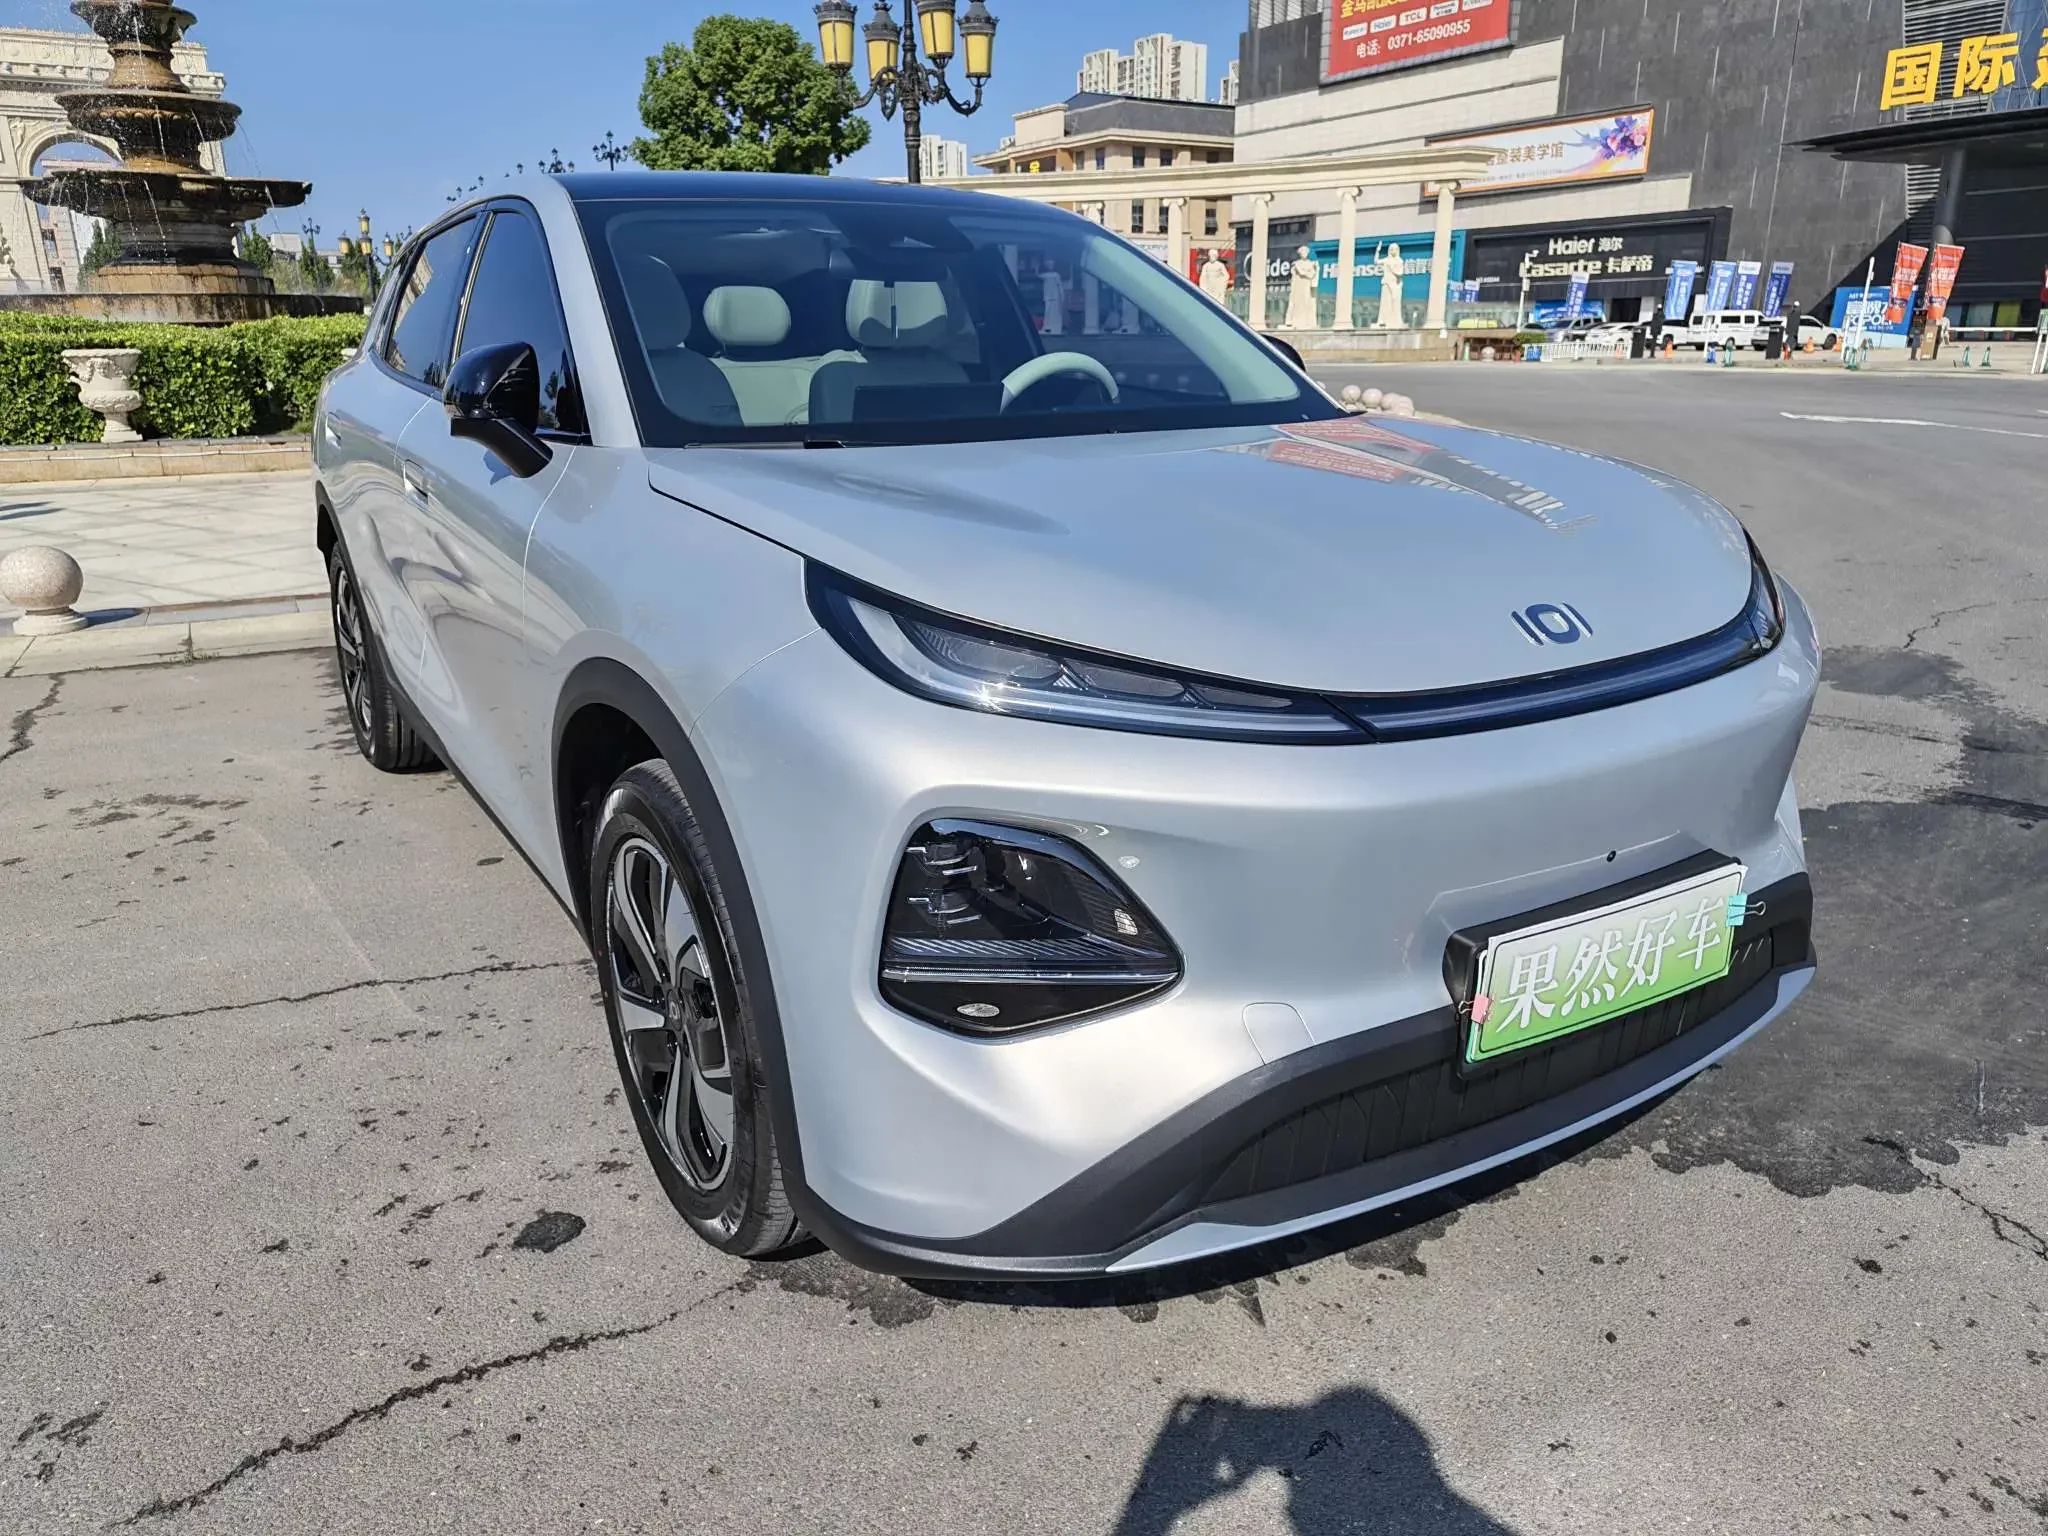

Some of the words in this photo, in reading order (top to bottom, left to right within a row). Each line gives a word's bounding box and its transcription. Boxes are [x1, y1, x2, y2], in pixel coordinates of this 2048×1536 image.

[1404, 11, 1423, 23] TCL
[1387, 19, 1471, 50] 0371-65090955
[1548, 236, 1595, 255] Haier
[1598, 236, 1624, 252] 海尔
[1606, 255, 1654, 274] 卡萨帝
[1496, 897, 1726, 1034] 果然好车
